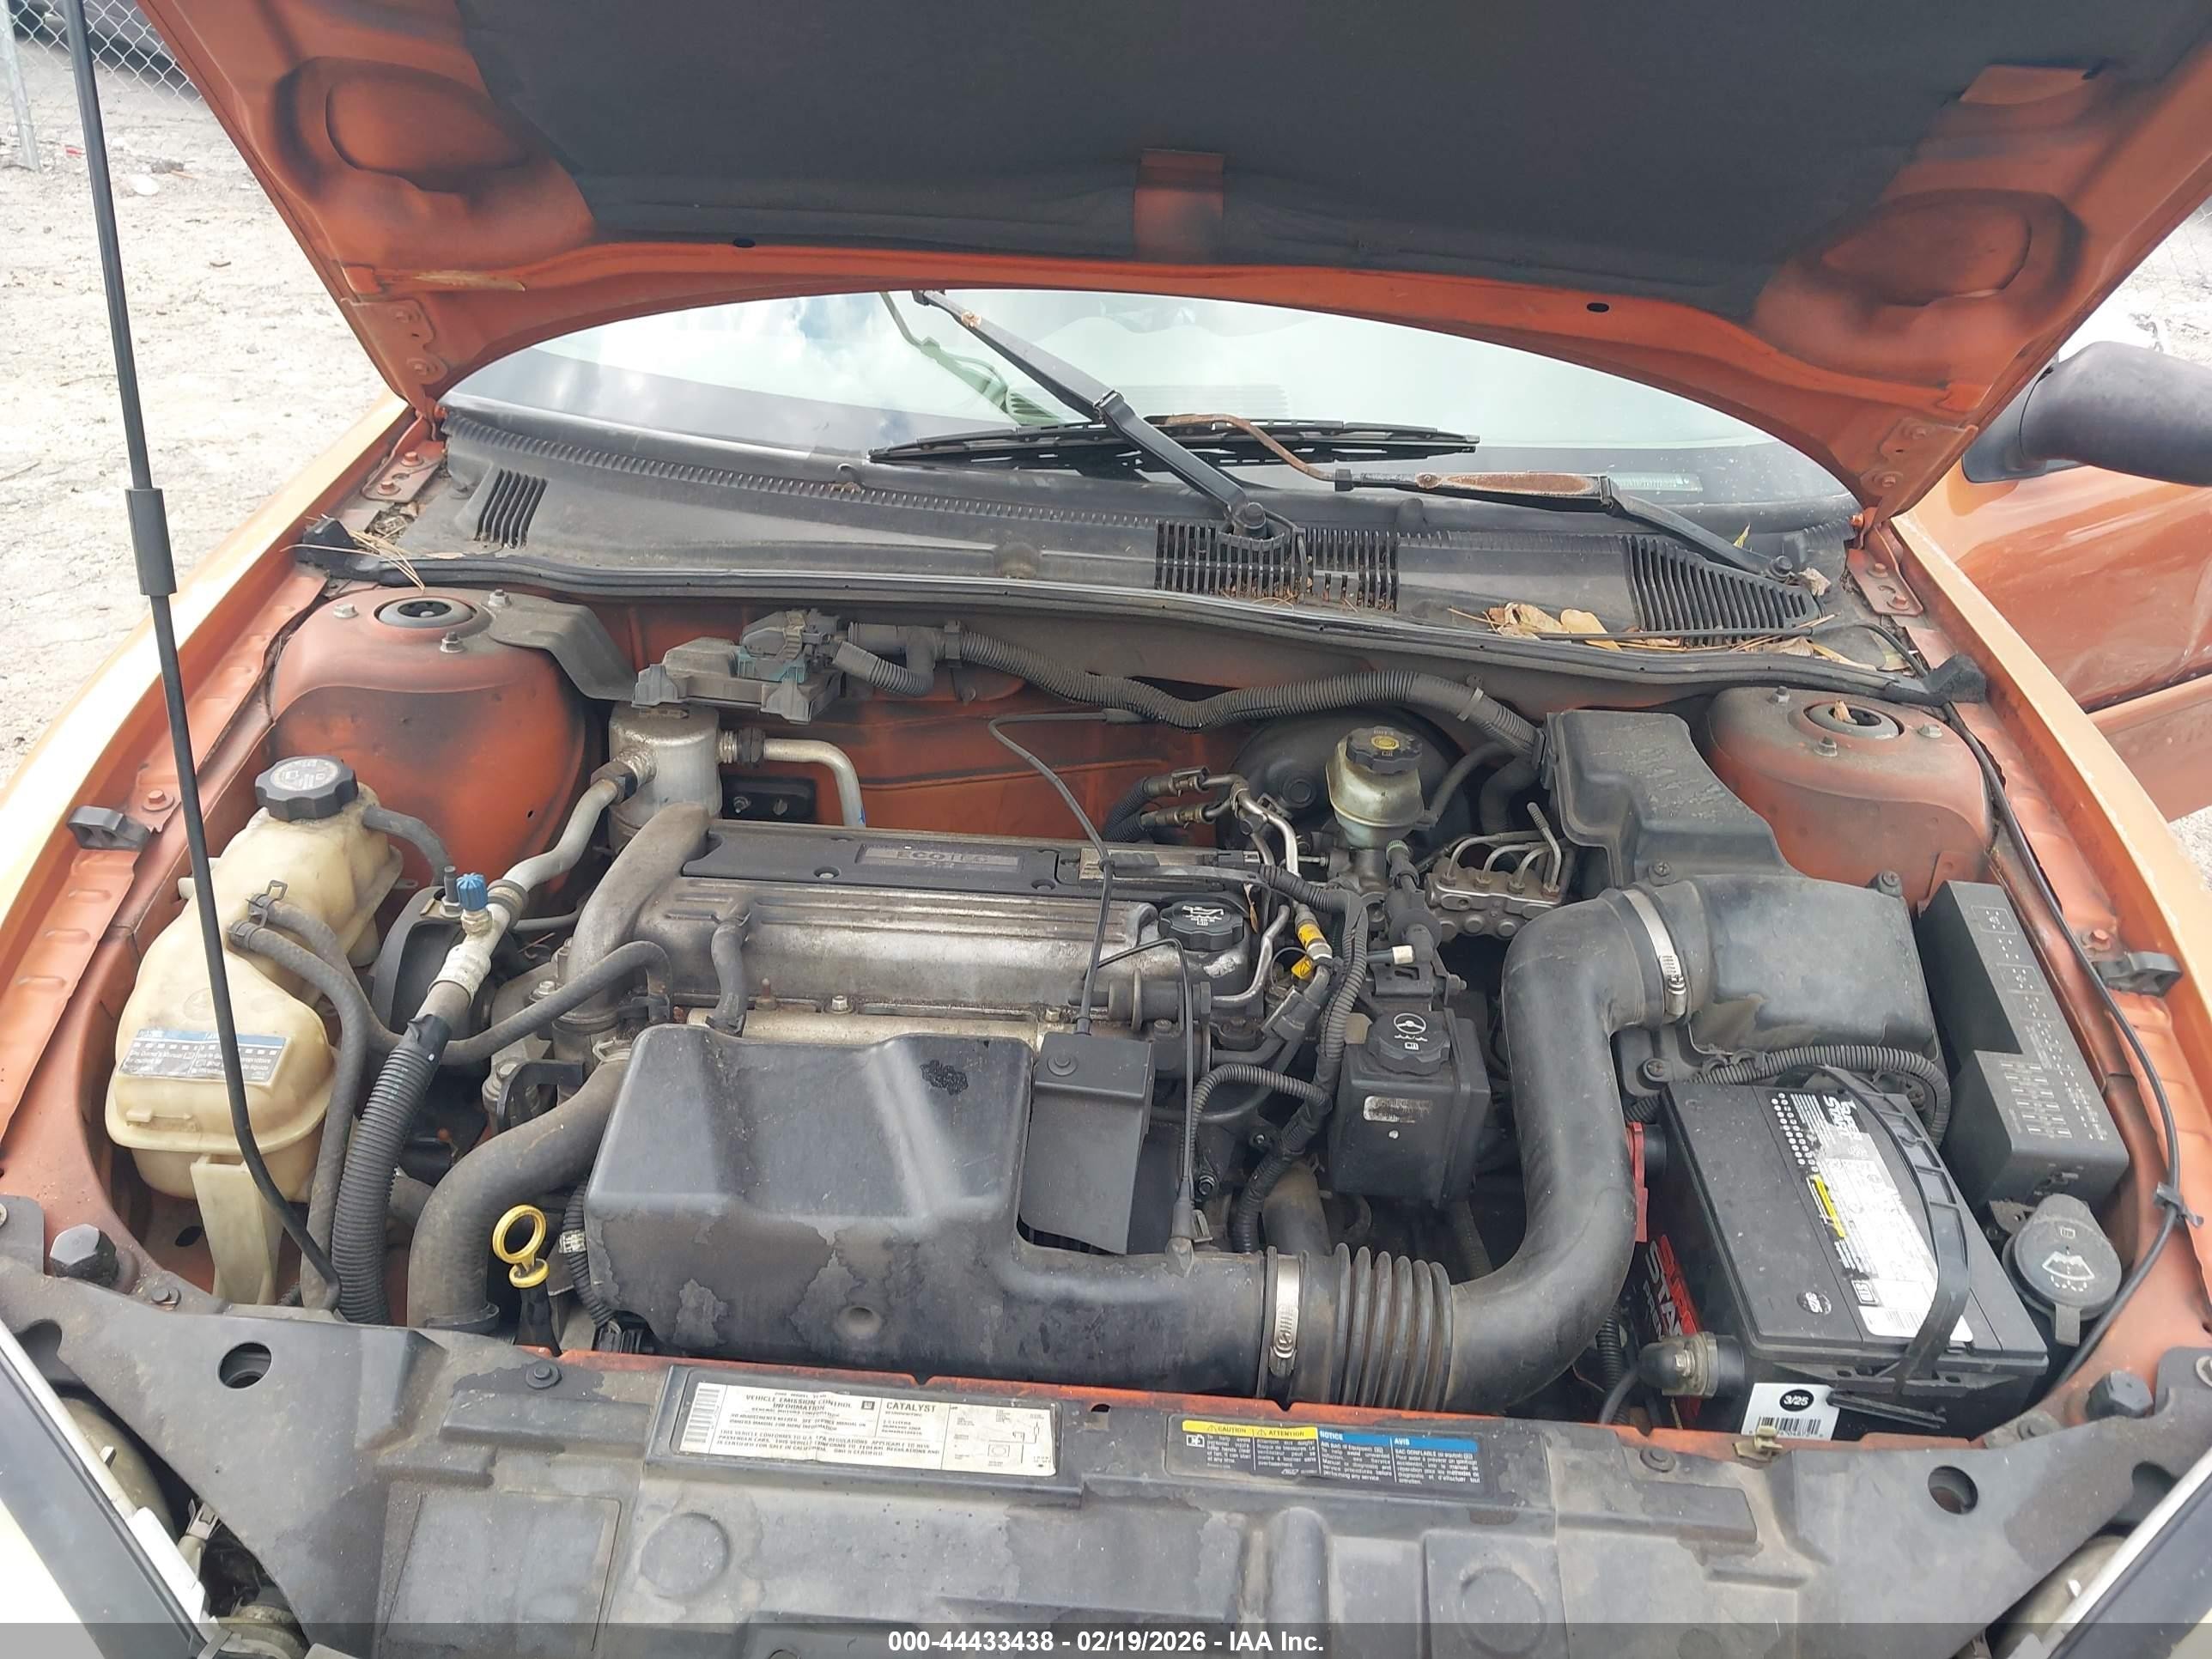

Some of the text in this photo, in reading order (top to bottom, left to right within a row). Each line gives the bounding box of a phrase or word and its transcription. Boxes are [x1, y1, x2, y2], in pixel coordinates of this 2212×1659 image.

[779, 1396, 816, 1405] EMISSION
[817, 1398, 852, 1408] CONTROL
[886, 1401, 936, 1413] CATALYST
[1783, 1395, 1809, 1407] 3/25
[1320, 1431, 1343, 1440] NOTICE
